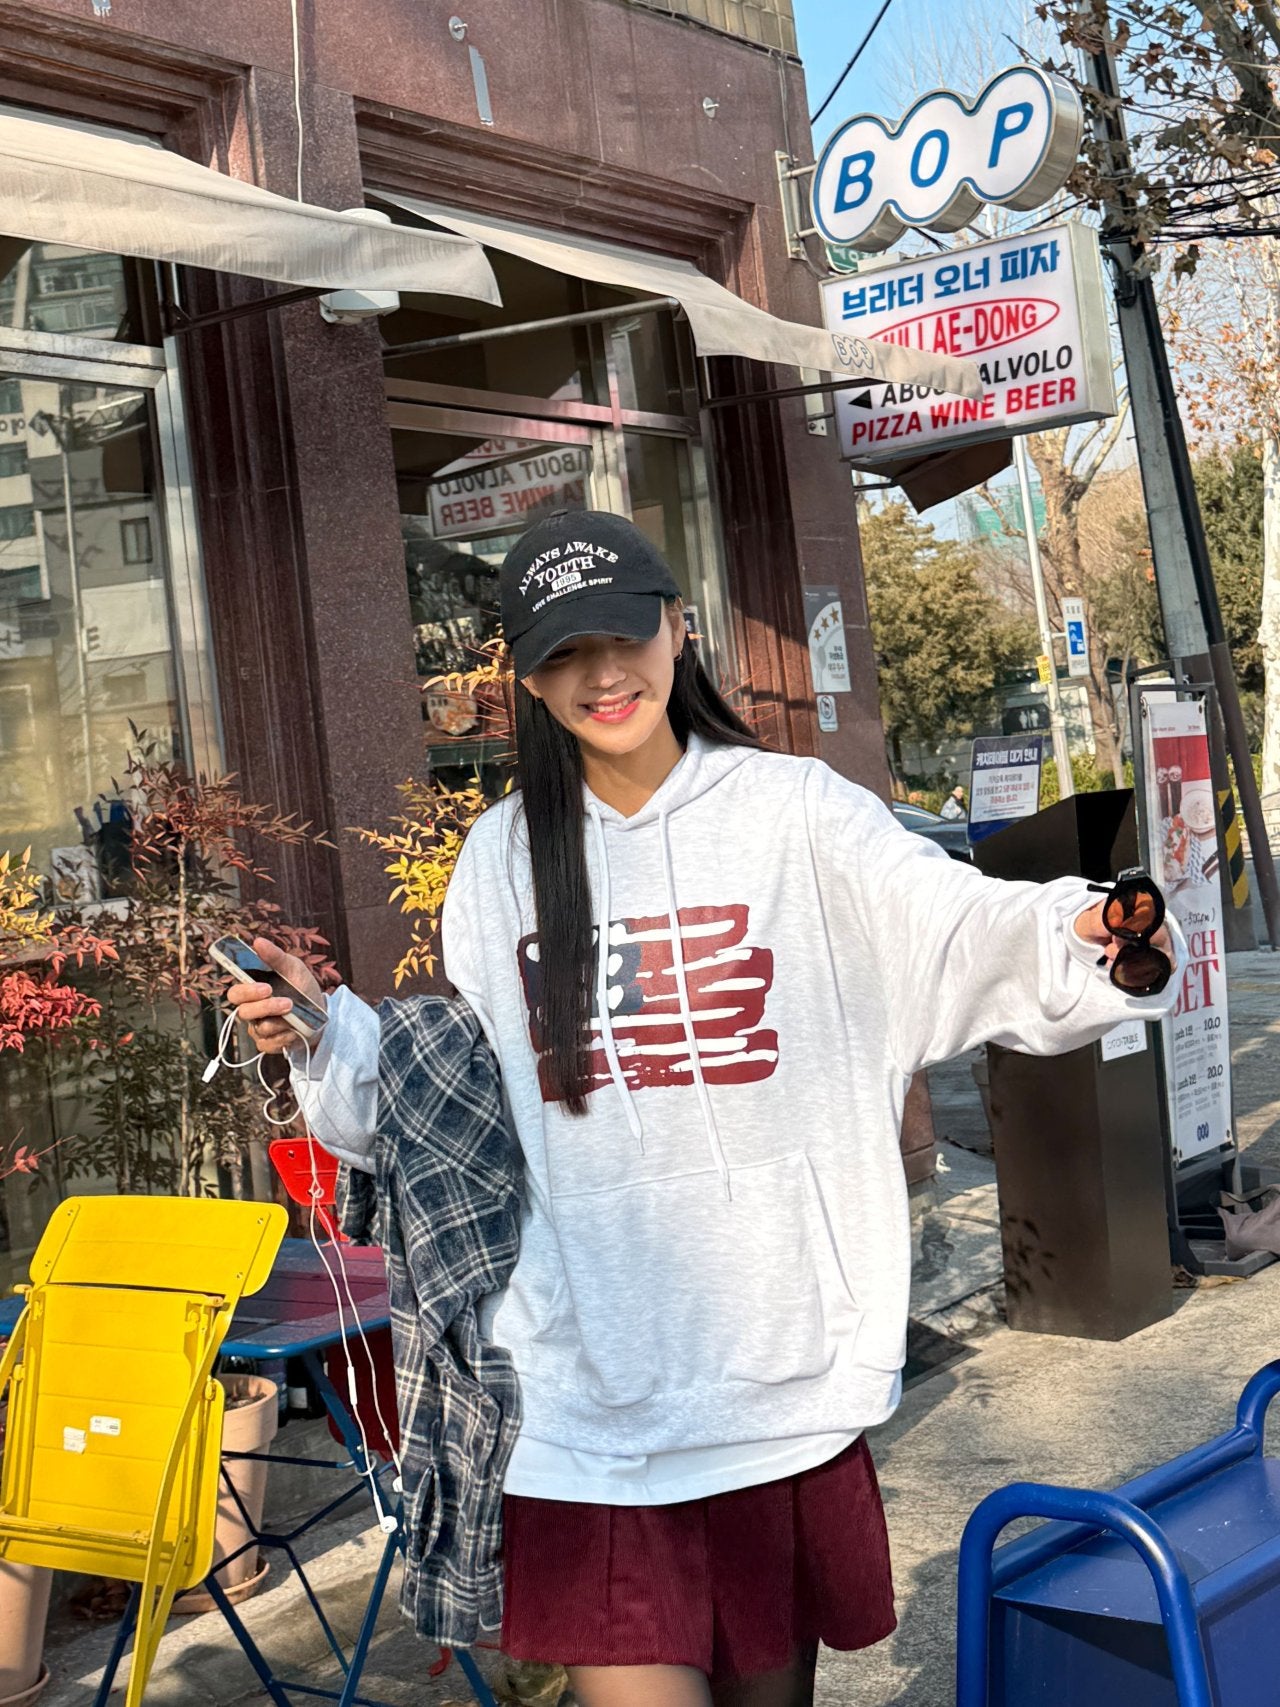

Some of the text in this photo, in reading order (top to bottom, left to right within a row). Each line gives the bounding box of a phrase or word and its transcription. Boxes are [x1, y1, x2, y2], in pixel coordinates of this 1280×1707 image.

[833, 101, 1034, 214] BOP
[842, 239, 1060, 320] 브라더 오너 피자
[978, 345, 1073, 386] ALVOLO
[852, 377, 1076, 445] PIZZA WINE BEER
[519, 541, 619, 596] ALWAYS AWAKE
[534, 555, 596, 588] YOUTH
[532, 599, 546, 613] LOVE
[588, 577, 613, 586] SPIRIT
[1204, 1016, 1221, 1031] 10.0
[1207, 1063, 1224, 1080] 20.0
